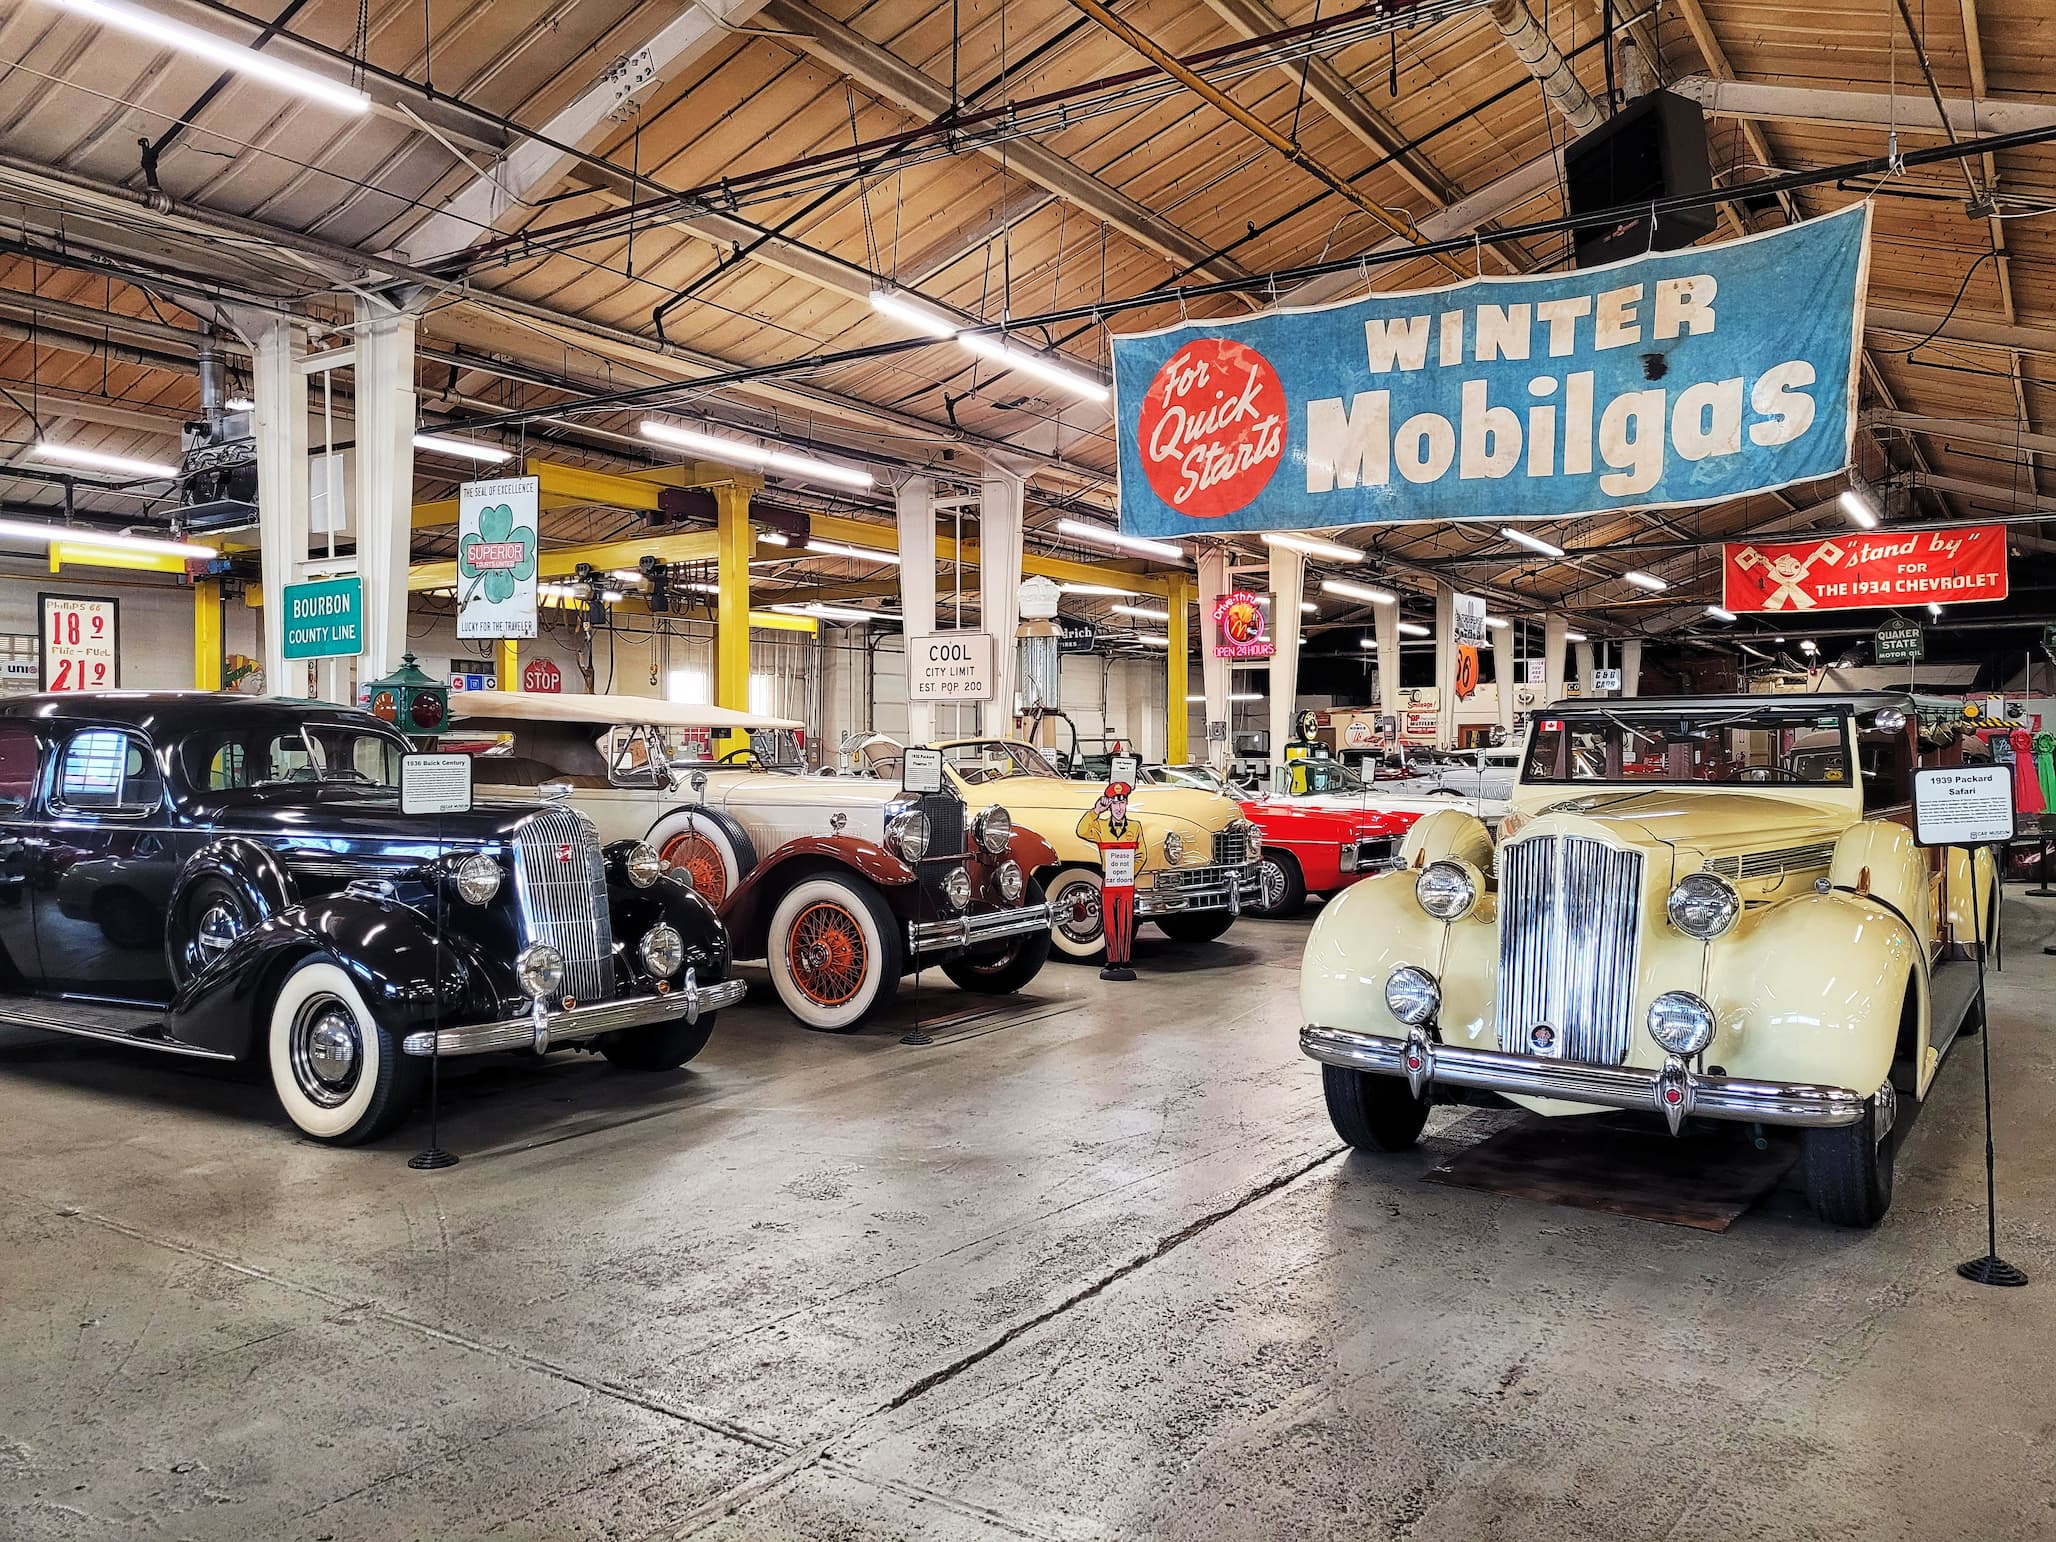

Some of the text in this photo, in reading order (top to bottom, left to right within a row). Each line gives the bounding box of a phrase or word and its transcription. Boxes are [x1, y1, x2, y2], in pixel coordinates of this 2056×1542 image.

[1364, 274, 1718, 374] WINTER
[1161, 356, 1211, 407] For
[1149, 363, 1265, 461] Quick
[1305, 360, 1817, 498] Mobilgas
[1173, 421, 1284, 504] Starts
[463, 482, 534, 498] THE SEAL OF EXCELLENCE
[468, 544, 523, 561] SUPERIOR
[1897, 563, 1928, 575] FOR
[1816, 572, 2000, 597] THE 1934 CHEVROLET
[293, 593, 351, 619] BOURBON
[461, 621, 533, 632] LUCKY FOR THE TRAVELER
[288, 624, 356, 645] COUNTY LINE
[1877, 629, 1920, 641] QUAKER
[1213, 647, 1236, 657] OPEN
[1247, 643, 1275, 656] HOURS
[1882, 639, 1918, 650] STATE
[929, 644, 972, 662] COOL
[1878, 650, 1923, 660] MOTOR OIL
[925, 666, 975, 678] CITY LIMIT
[526, 671, 560, 690] STOP
[919, 681, 982, 693] EST. POP. 200
[441, 760, 465, 768] Century
[1930, 774, 1994, 785] 1939 Packard
[1948, 787, 1976, 796] Safari
[1112, 869, 1128, 877] open
[1116, 875, 1133, 884] doors
